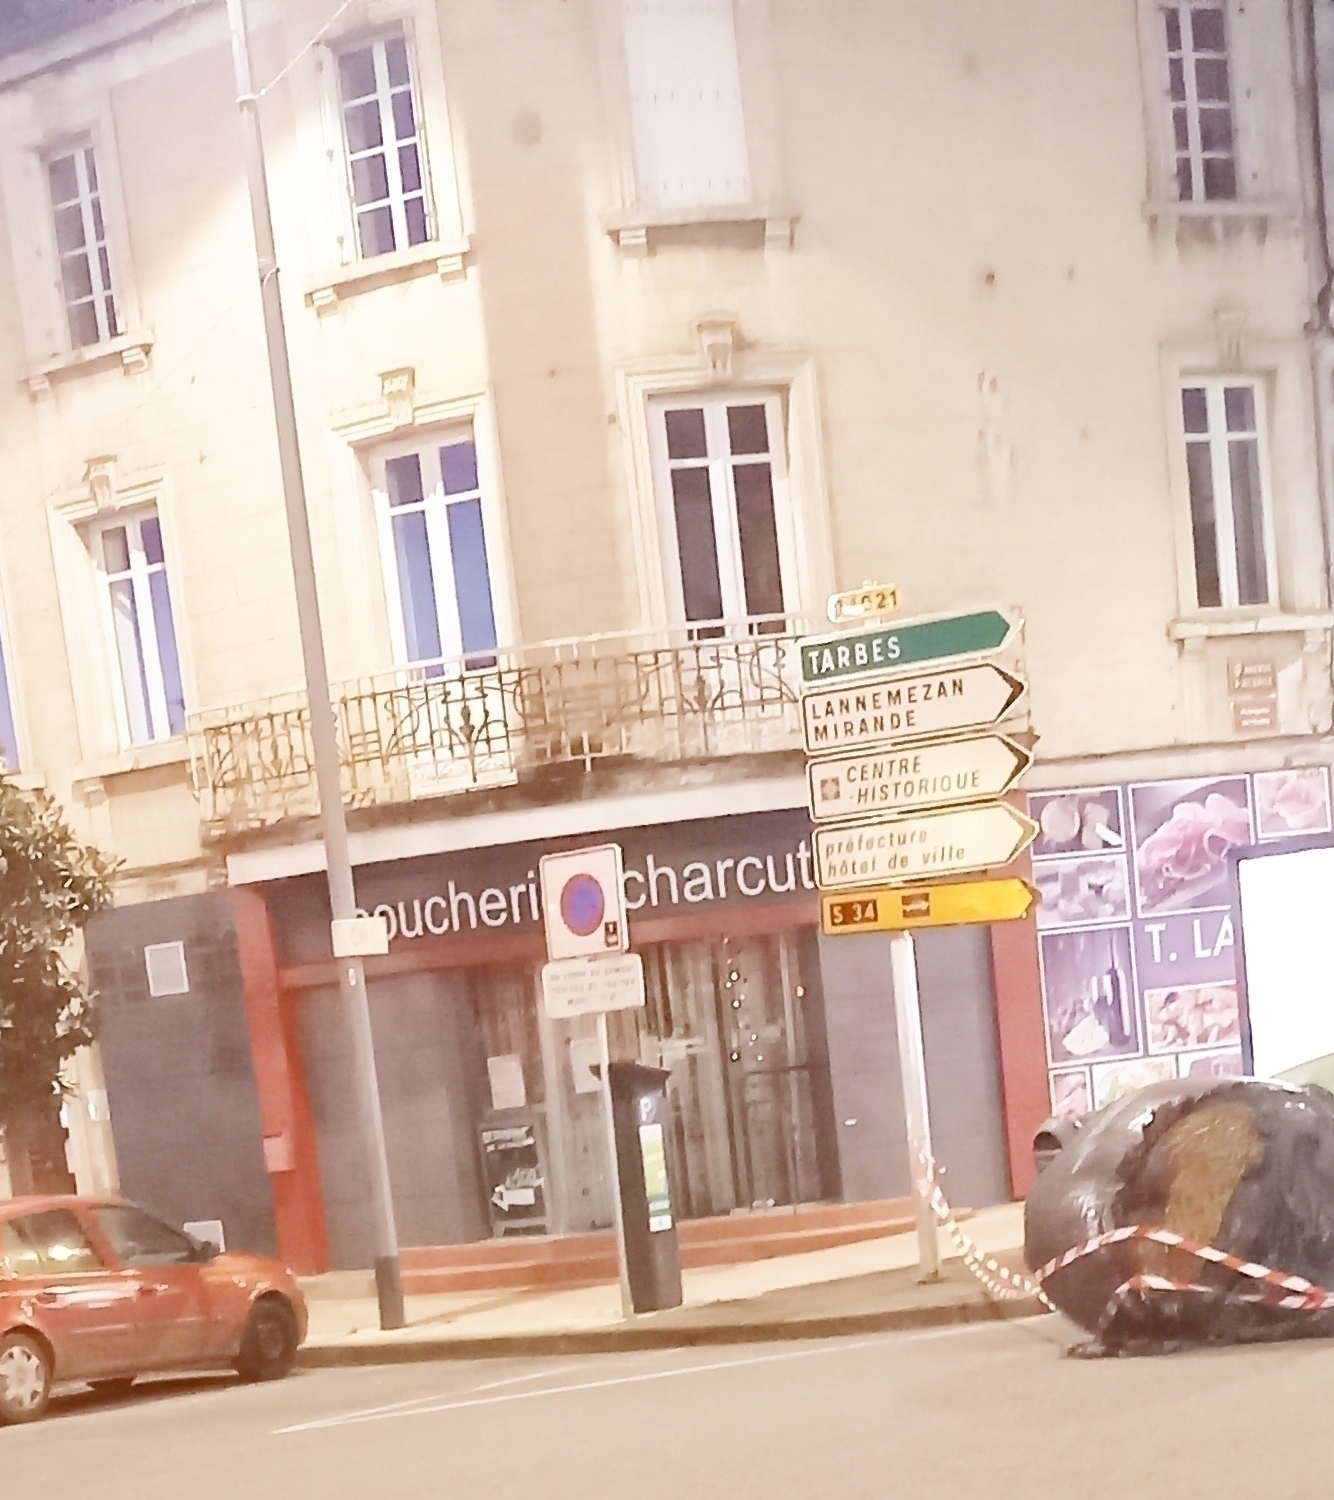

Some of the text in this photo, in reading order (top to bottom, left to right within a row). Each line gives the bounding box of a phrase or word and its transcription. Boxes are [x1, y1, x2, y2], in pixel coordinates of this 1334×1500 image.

[808, 636, 901, 675] TARBES
[812, 678, 964, 720] LANNEMEZAN
[814, 710, 917, 742] MIRANDE
[846, 755, 922, 783] CENTRE
[825, 829, 928, 860] préfecture
[827, 843, 966, 879] hôtel de ville
[851, 901, 876, 920] 34
[639, 1095, 653, 1122] P
